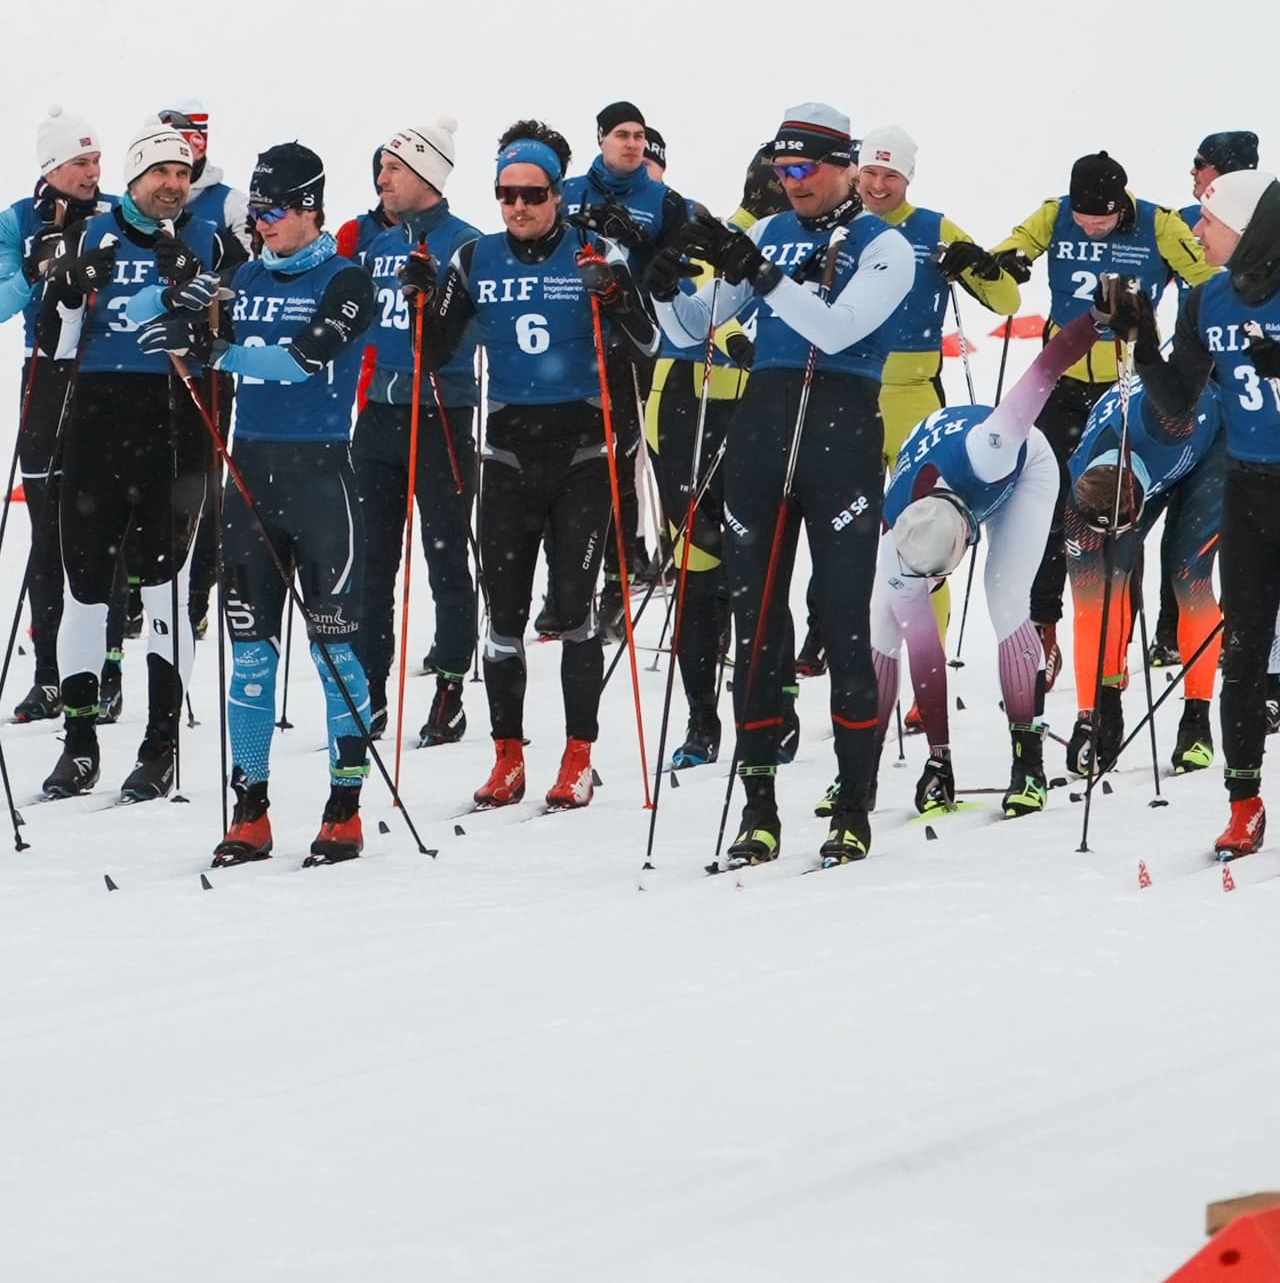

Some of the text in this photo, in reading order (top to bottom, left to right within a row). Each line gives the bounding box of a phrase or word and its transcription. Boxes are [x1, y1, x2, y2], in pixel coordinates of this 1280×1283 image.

[1057, 241, 1108, 262] RIF
[113, 261, 154, 284] IF
[440, 275, 456, 317] CRAFT
[477, 276, 539, 304] RIF
[233, 295, 285, 322] RIF
[378, 288, 410, 330] 25
[515, 313, 551, 355] 6
[582, 537, 596, 571] CRAFT
